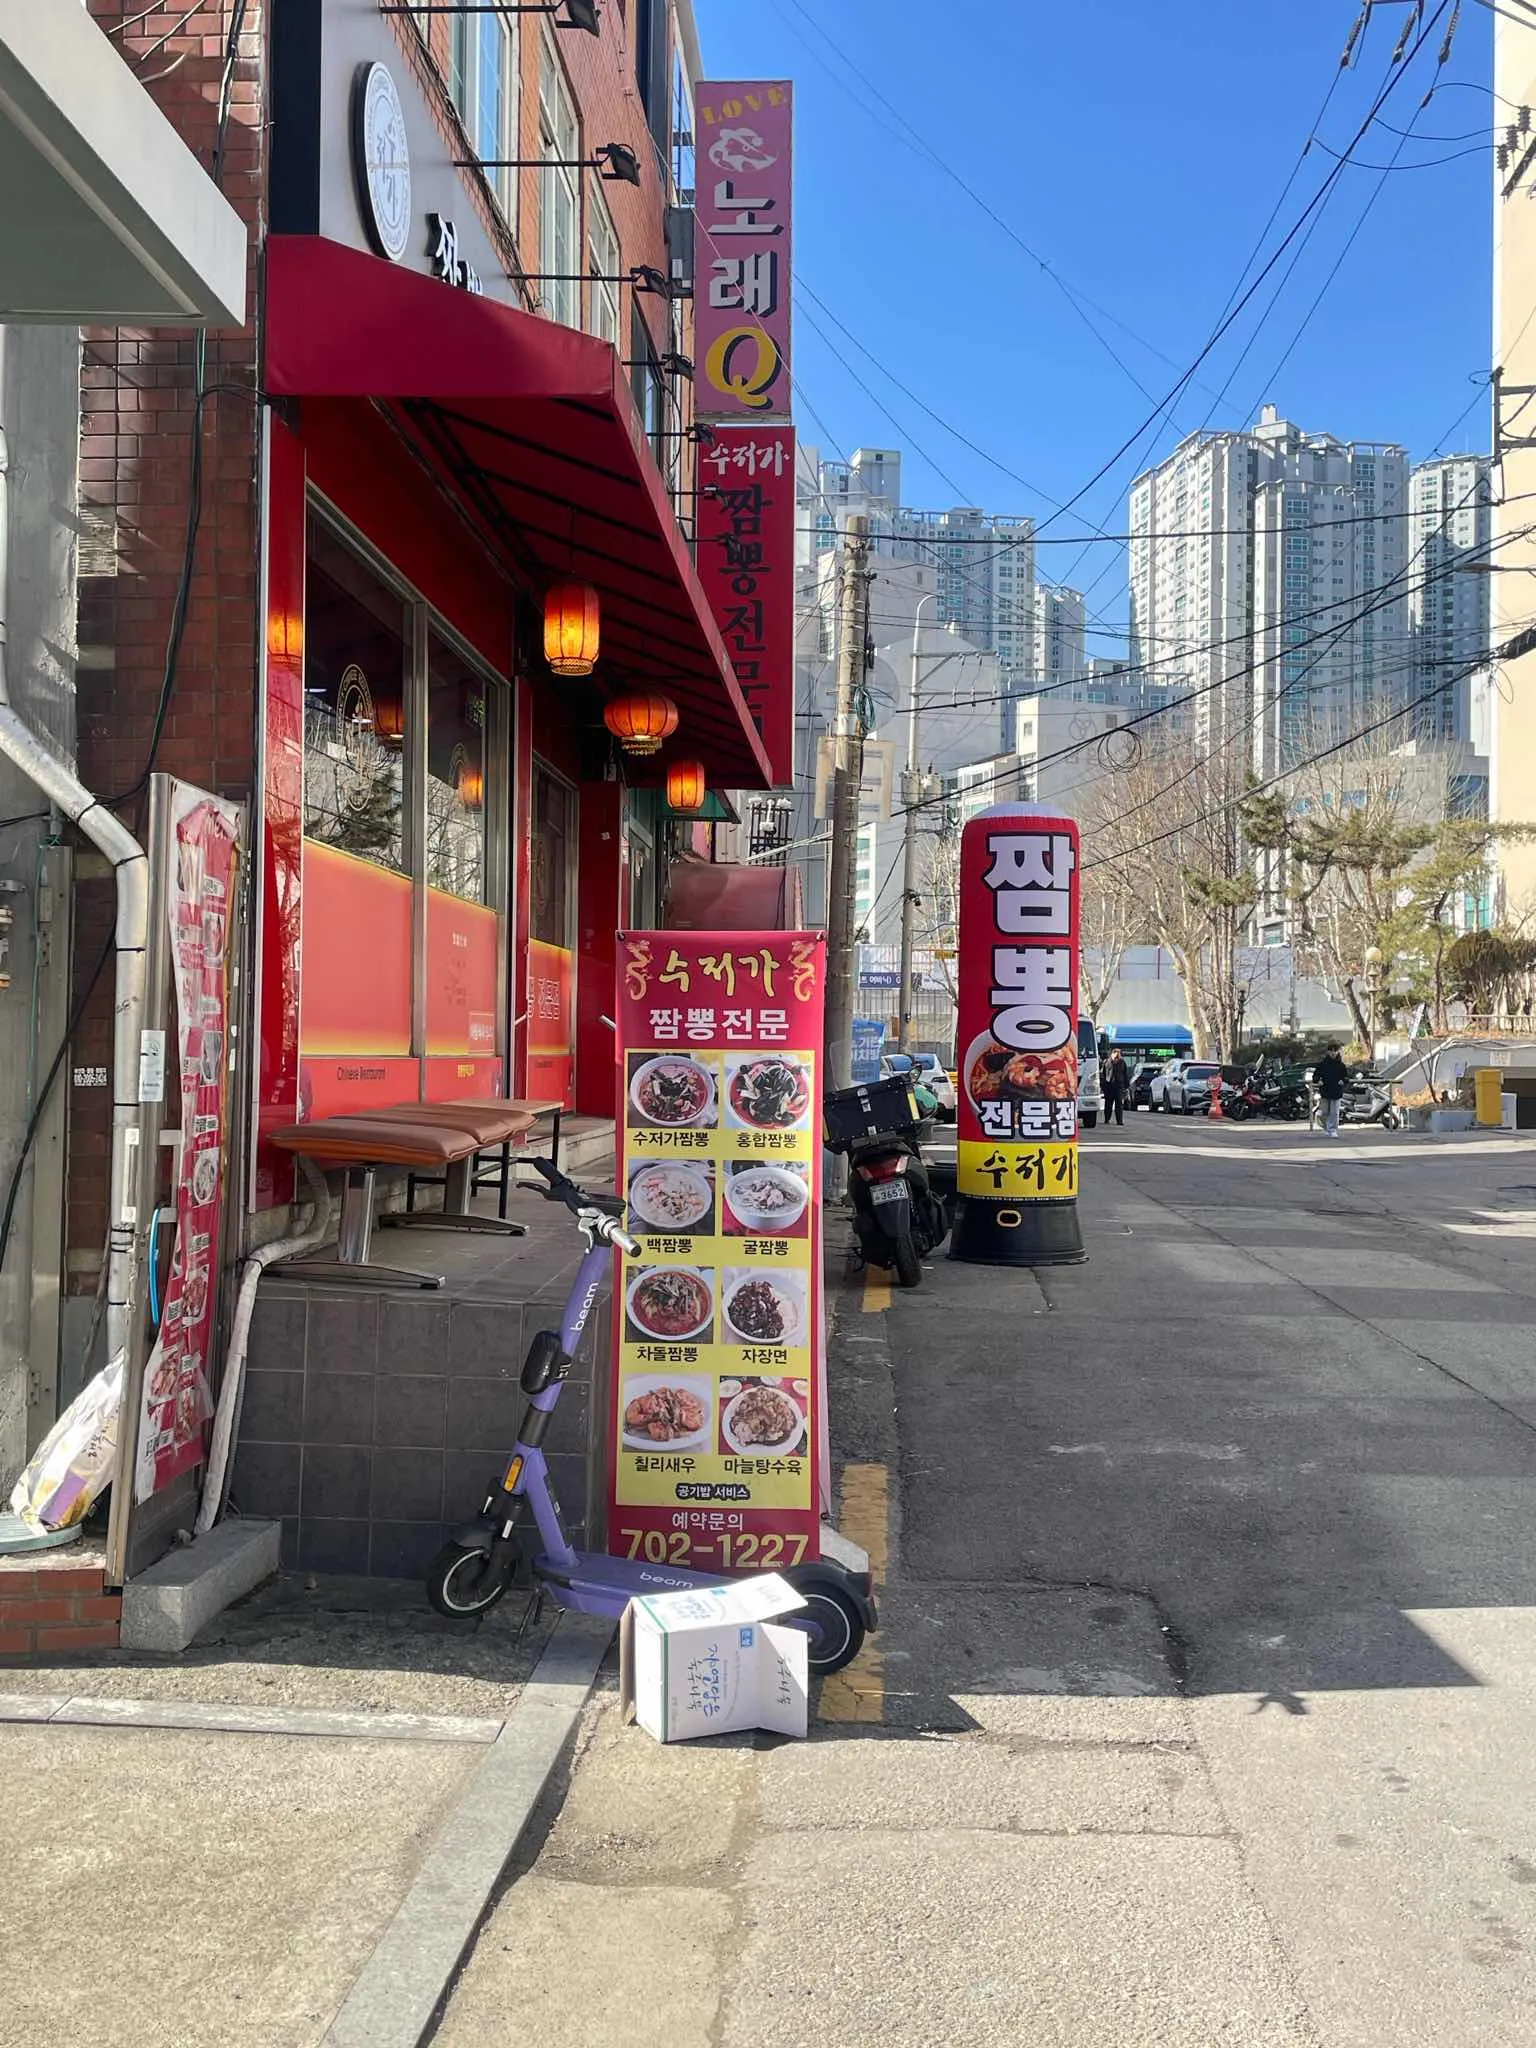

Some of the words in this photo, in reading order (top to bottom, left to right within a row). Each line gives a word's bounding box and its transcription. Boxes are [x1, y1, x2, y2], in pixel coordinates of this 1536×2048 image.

[702, 87, 788, 125] LOVE
[705, 179, 784, 410] 노래Q
[703, 441, 791, 476] 수저가
[719, 484, 773, 736] 짬뽕전문
[984, 831, 1076, 1052] 짬뽕
[658, 949, 780, 997] 수저가
[649, 1008, 790, 1040] 짬뽕전문
[979, 1099, 1077, 1139] 전문점
[632, 1131, 710, 1148] 수저가짬뽕
[736, 1132, 797, 1148] 홍합짬뽕
[976, 1148, 1077, 1191] 수저가
[647, 1238, 692, 1253] 백짬뽕
[743, 1240, 788, 1255] 굴짬뽕
[569, 1281, 599, 1332] beam
[637, 1346, 698, 1362] 차돌짬뽕
[742, 1349, 788, 1365] 자장면
[634, 1456, 696, 1473] 칠리새우
[724, 1459, 803, 1476] 마늘탕수육
[677, 1485, 712, 1499] 공기밥
[714, 1486, 749, 1500] 서비스
[672, 1512, 744, 1531] 예약문의
[620, 1529, 809, 1568] 702-1227
[639, 1571, 694, 1589] beam
